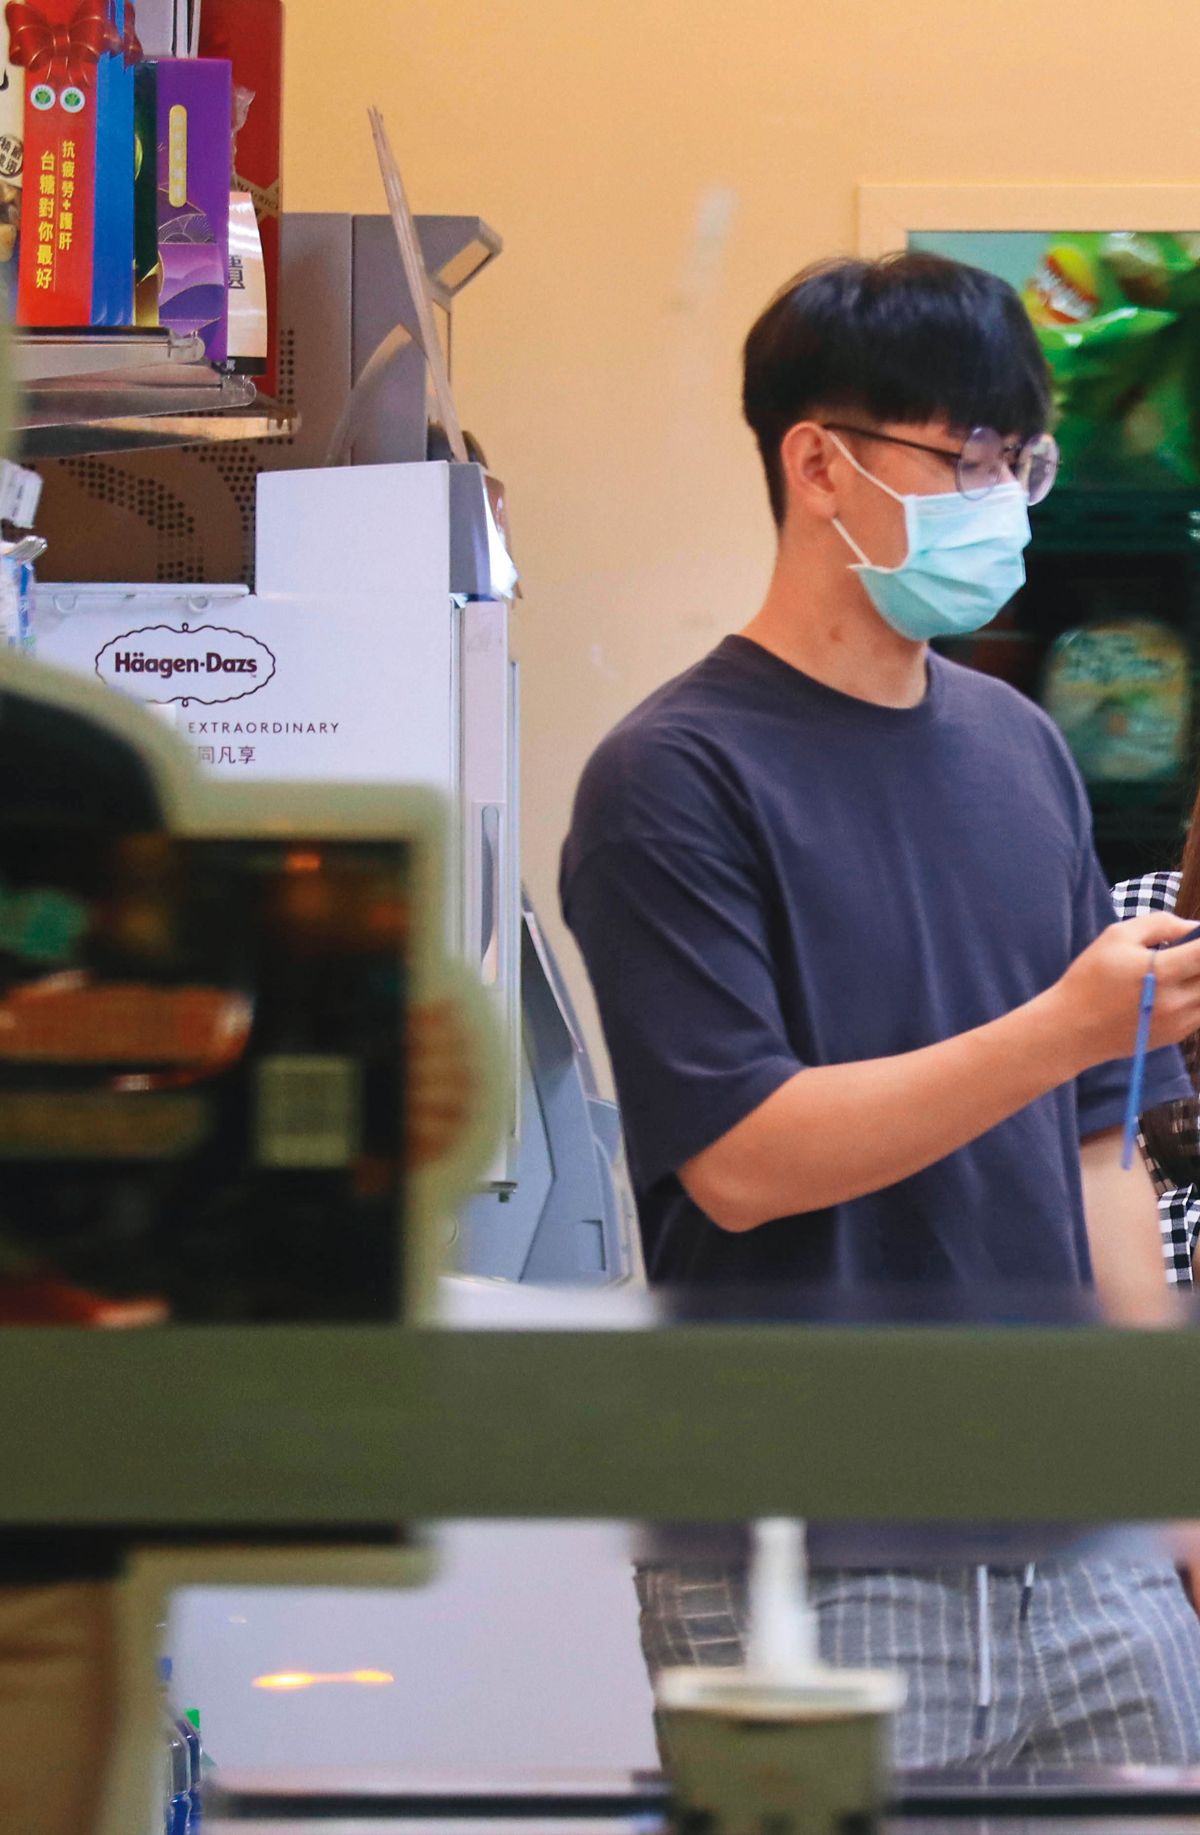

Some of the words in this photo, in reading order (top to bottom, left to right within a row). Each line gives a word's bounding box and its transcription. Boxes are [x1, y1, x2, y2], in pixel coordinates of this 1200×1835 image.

[36, 150, 56, 290] 台糖對你最好
[114, 652, 258, 679] Häagen-Dazs
[187, 721, 340, 735] EXTRAORDINARY
